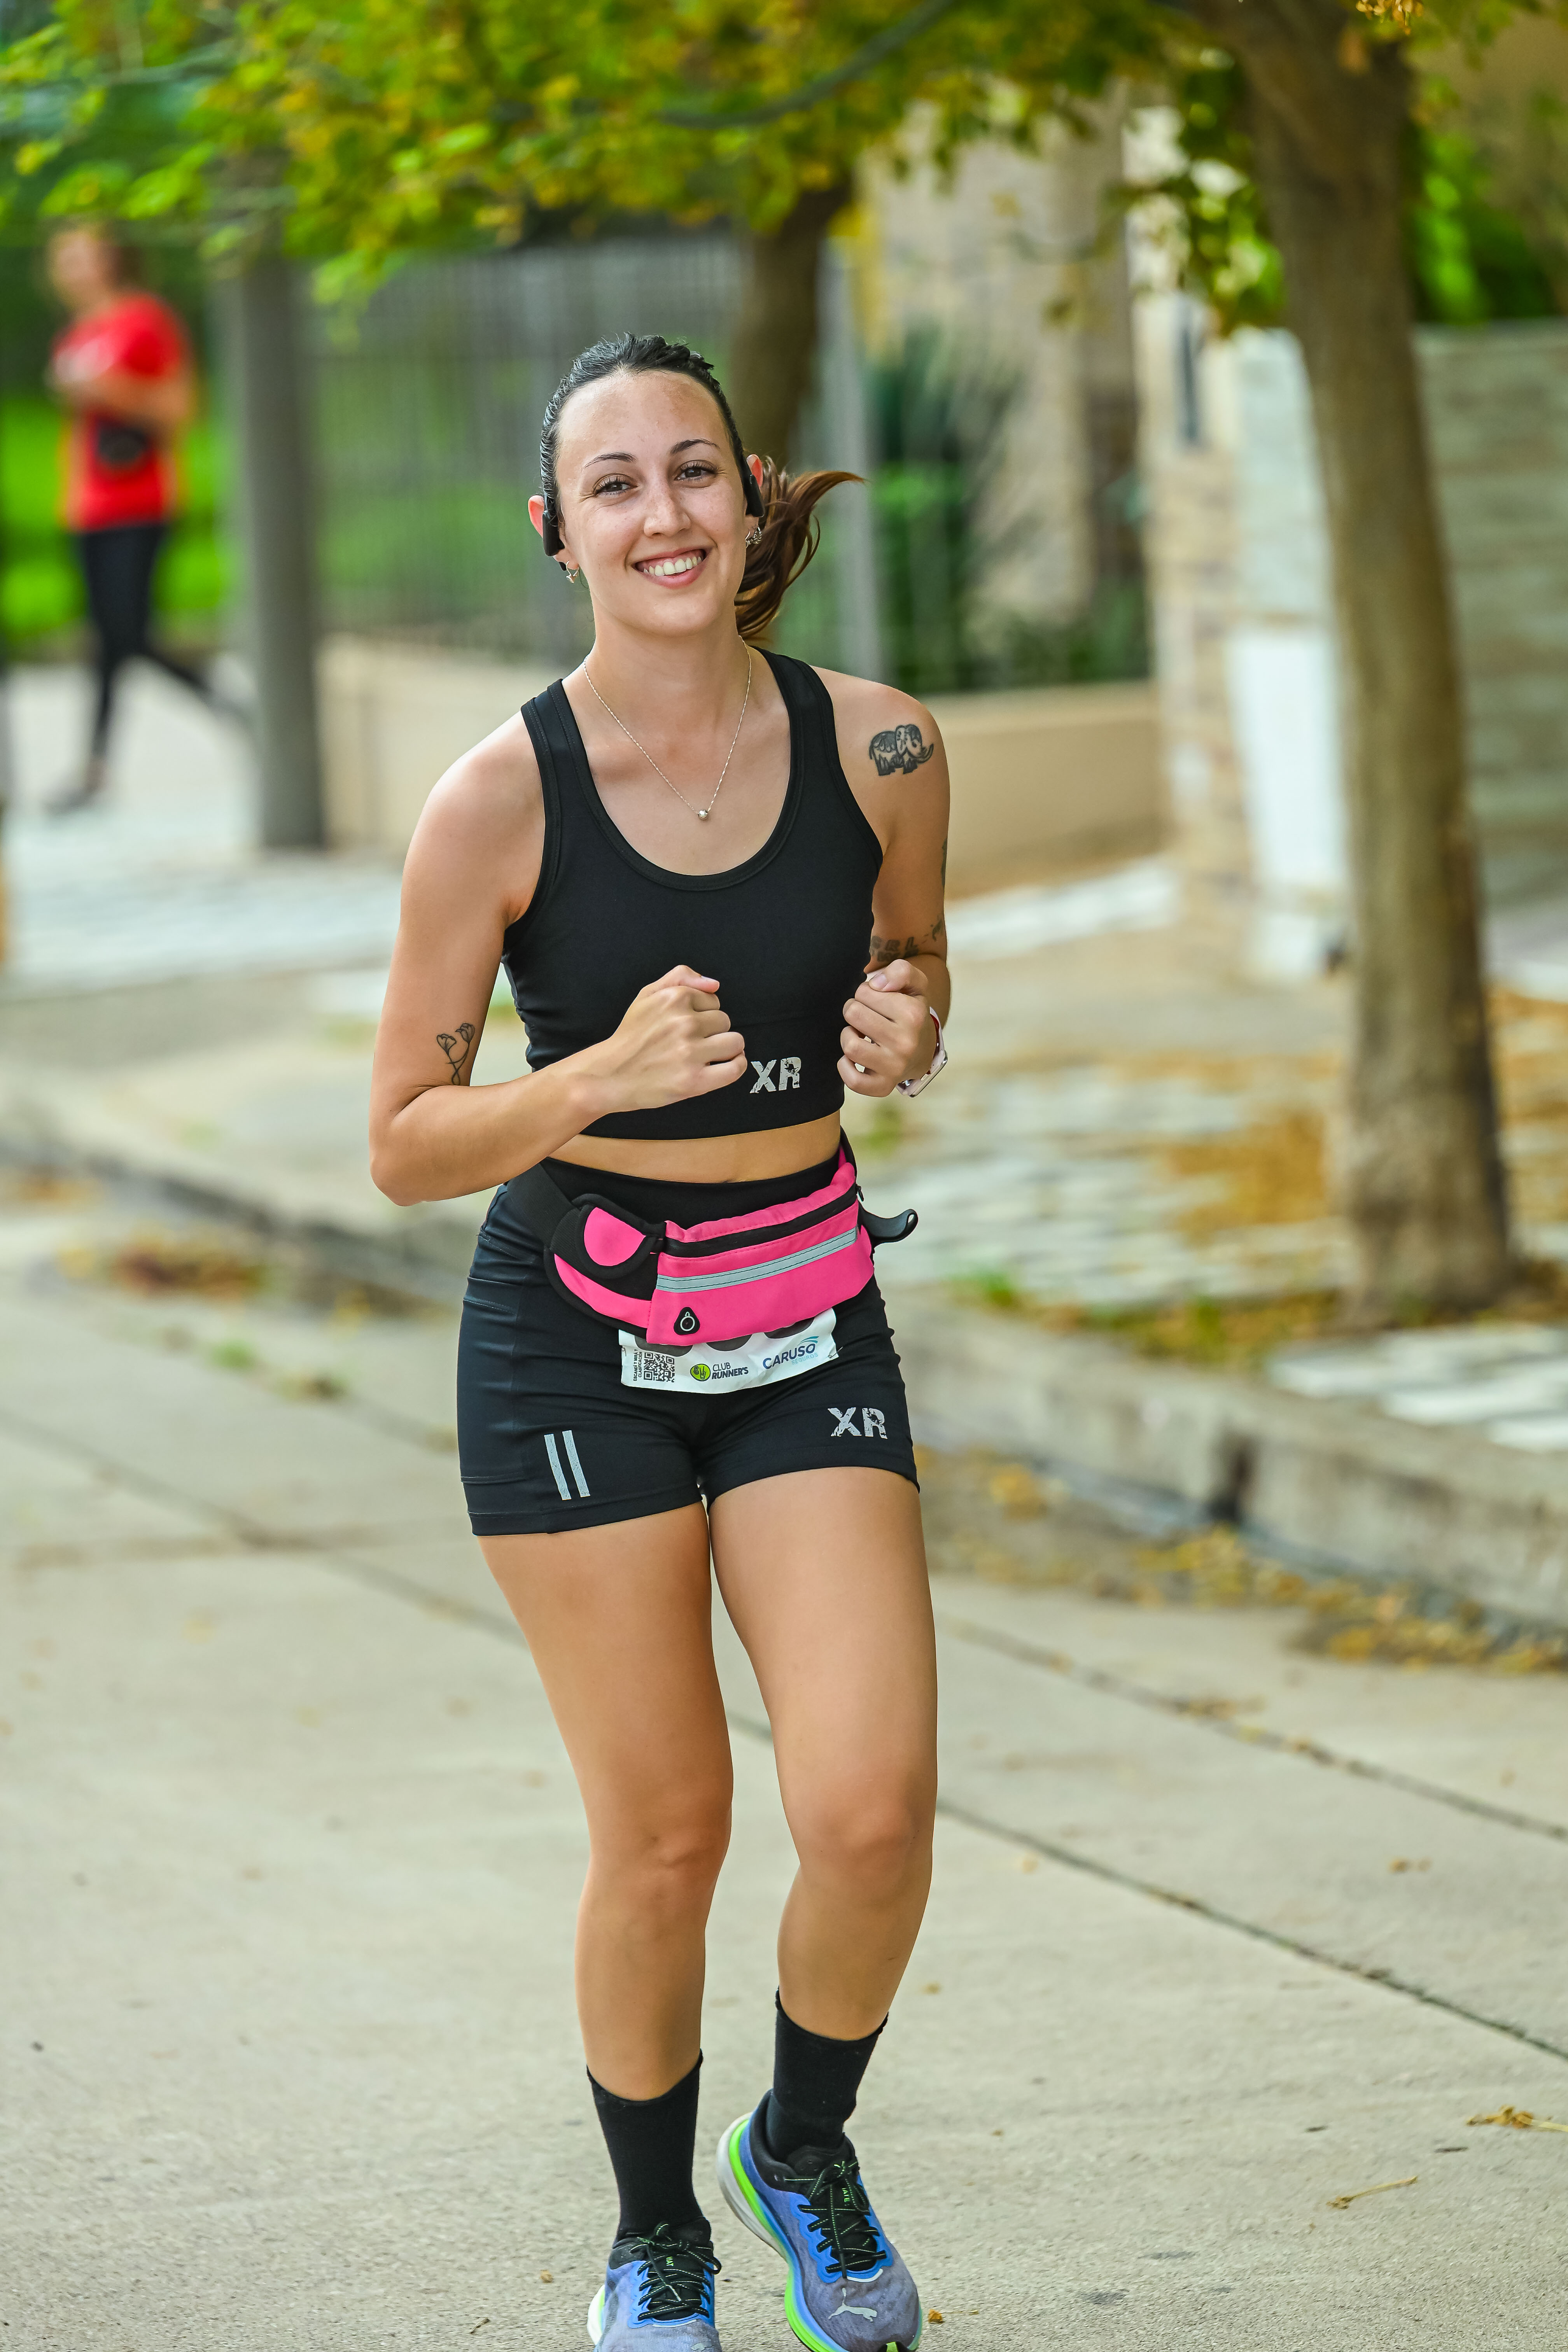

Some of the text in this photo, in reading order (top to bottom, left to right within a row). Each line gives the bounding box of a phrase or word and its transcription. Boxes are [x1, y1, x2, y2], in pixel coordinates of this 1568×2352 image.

[750, 1057, 801, 1094] XR
[763, 1343, 816, 1369] CARUSO
[792, 1353, 818, 1365] SEGUROS
[711, 1367, 748, 1379] RUNNER'S
[712, 1362, 731, 1371] CLUB
[828, 1407, 888, 1439] XR
